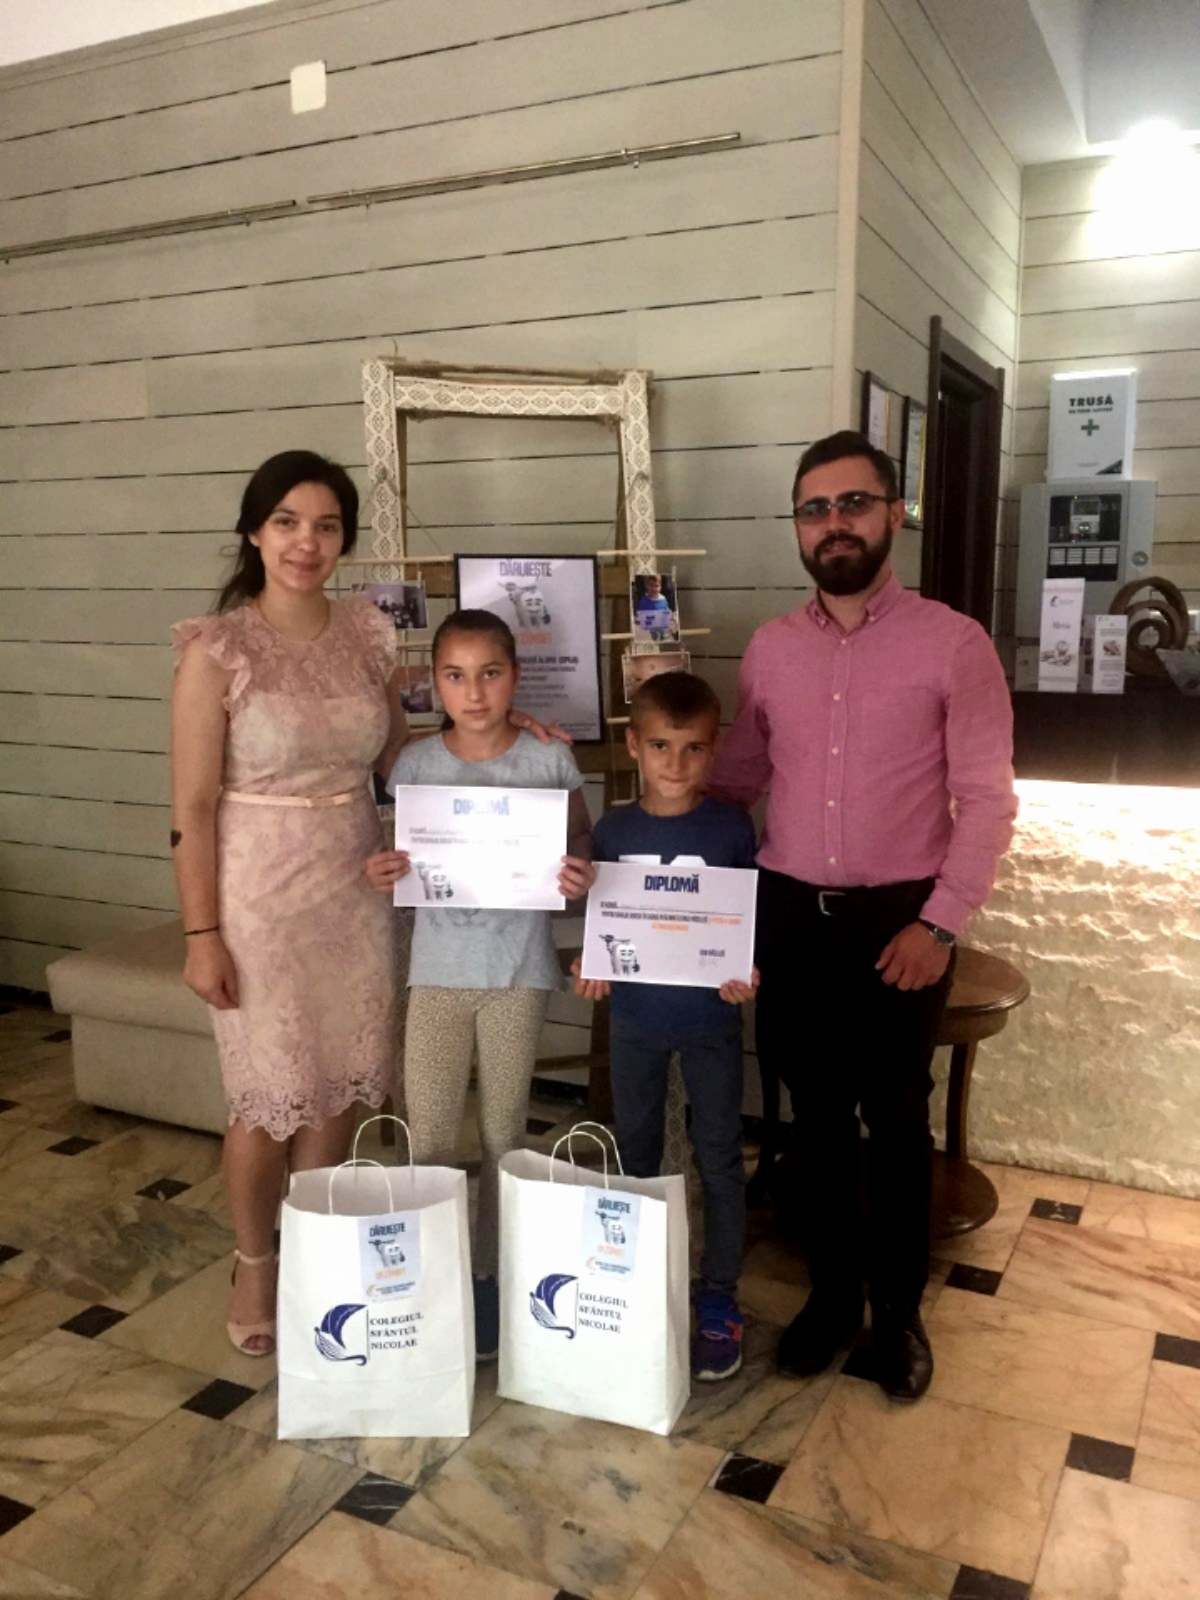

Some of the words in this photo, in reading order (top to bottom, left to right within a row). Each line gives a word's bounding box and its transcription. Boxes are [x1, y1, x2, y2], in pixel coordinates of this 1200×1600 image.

[644, 874, 699, 893] DIPLOMĂ
[579, 1292, 629, 1309] COLEGIUL
[369, 1312, 424, 1326] COLEGIUL
[578, 1304, 623, 1321] SFÂNTUL
[369, 1326, 418, 1338] SFÂNTUL
[578, 1317, 621, 1334] NICOLAE
[371, 1338, 418, 1350] NICOLAE
